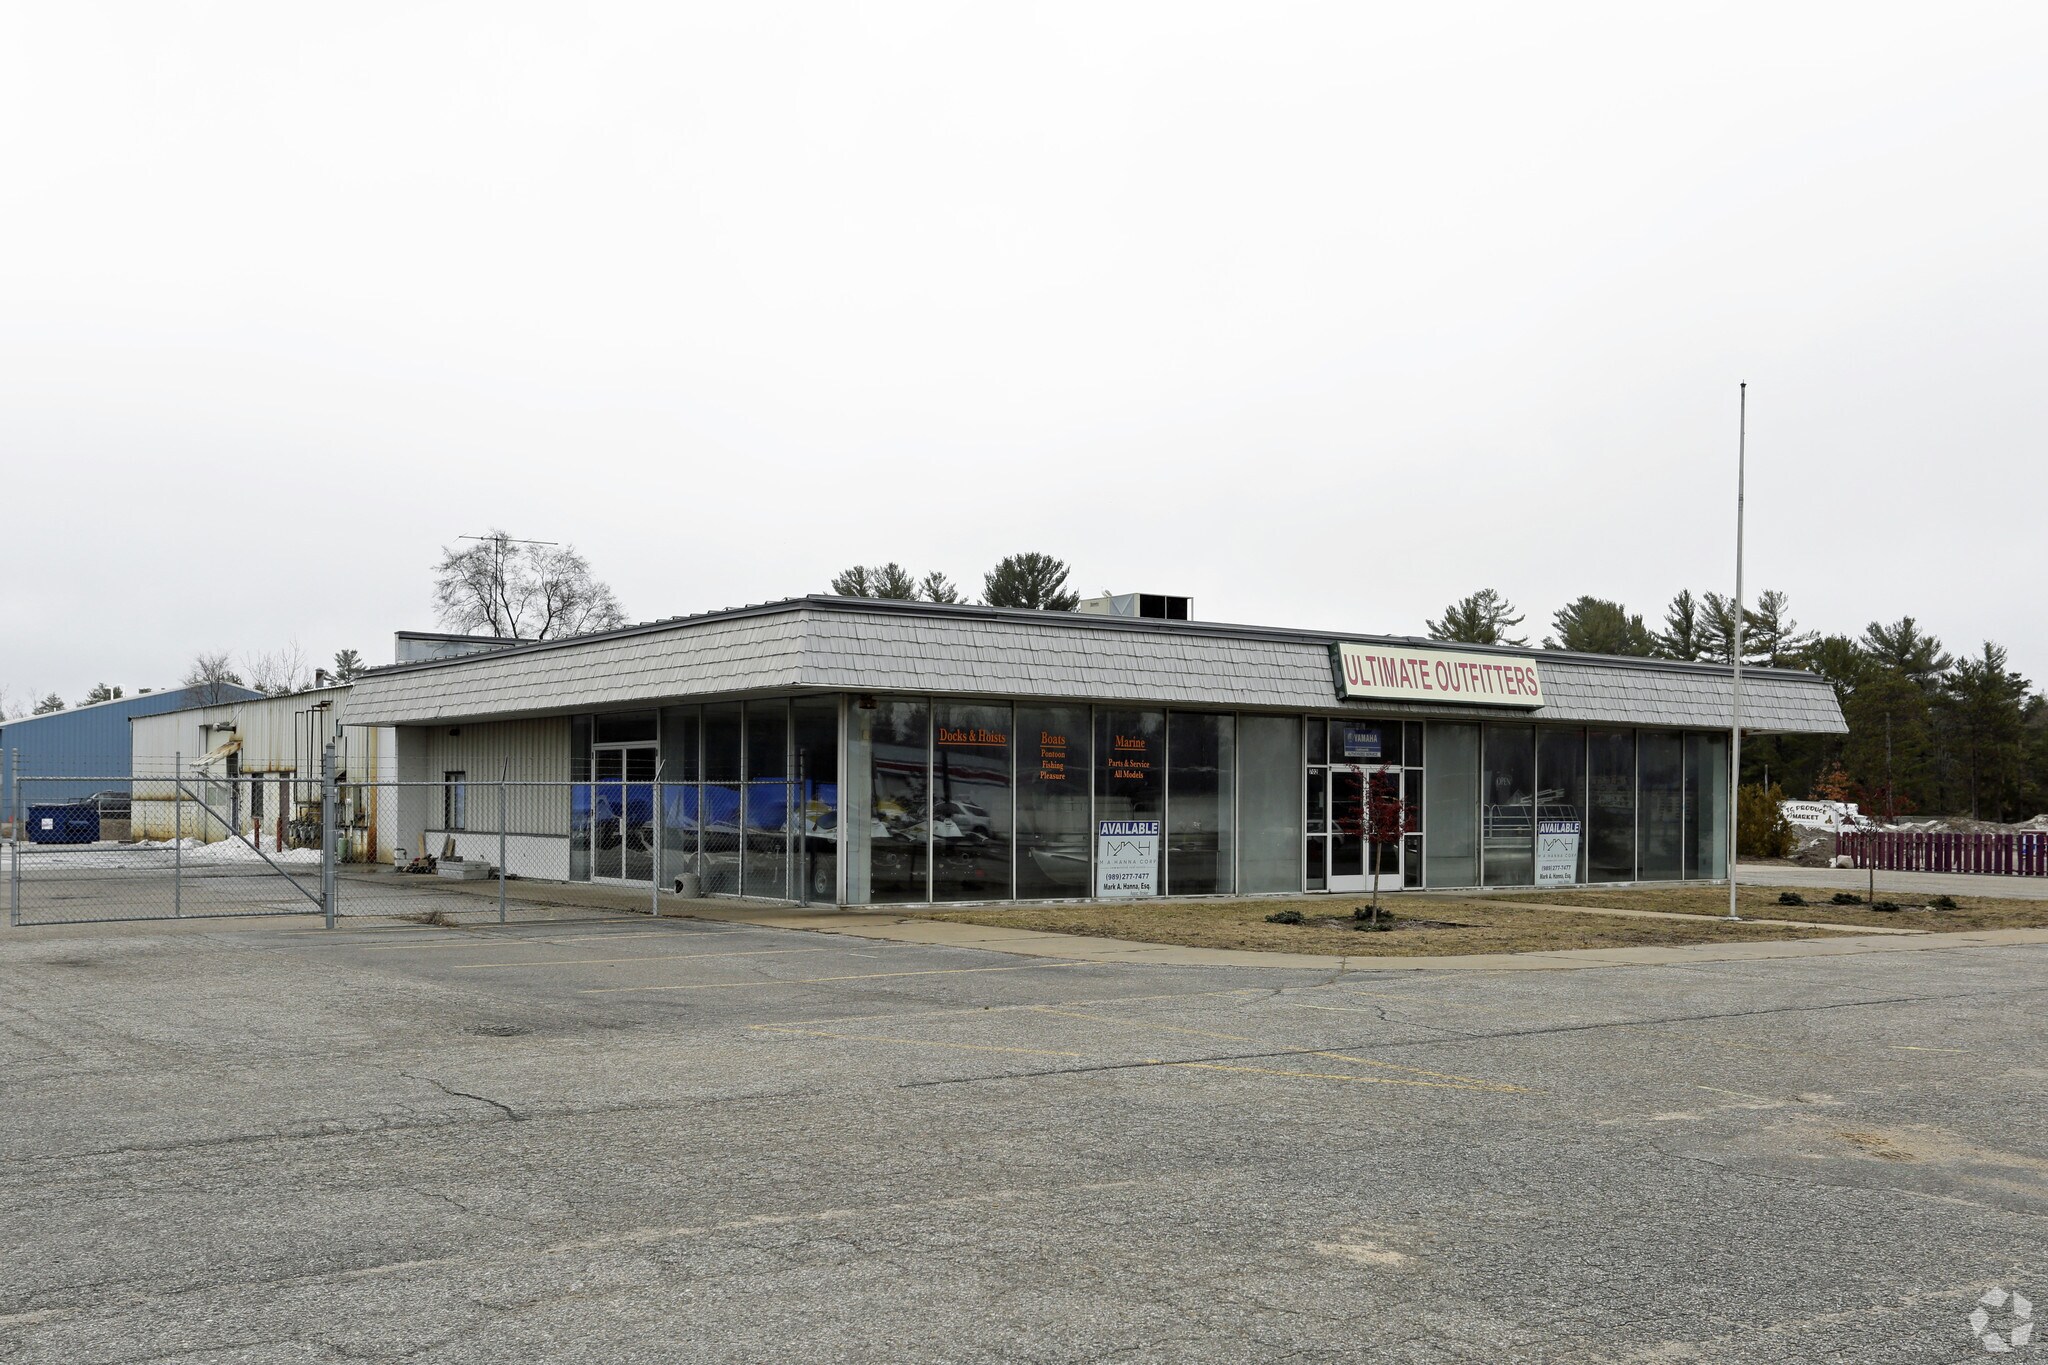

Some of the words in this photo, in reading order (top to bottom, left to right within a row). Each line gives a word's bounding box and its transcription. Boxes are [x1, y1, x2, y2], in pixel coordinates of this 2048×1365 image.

[1343, 653, 1433, 690] ULTIMATE
[1435, 660, 1538, 697] OUTFITTERS
[939, 728, 967, 744] Docks
[969, 730, 976, 743] &
[978, 729, 1006, 744] Hoists
[1041, 732, 1066, 745] Boats
[1354, 733, 1378, 743] YAMAHA
[1115, 735, 1145, 748] Marine
[1041, 749, 1066, 759] Pontoon
[1042, 760, 1064, 772] Fishing
[1108, 758, 1123, 768] Parts
[1124, 759, 1129, 768] &
[1130, 759, 1150, 769] Service
[1040, 770, 1066, 780] Pleasure
[1114, 770, 1122, 779] All
[1123, 770, 1144, 779] Models
[1496, 776, 1511, 786] OPEN
[1796, 805, 1827, 815] PRODUCE
[1101, 822, 1158, 835] AVAILABLE
[1540, 823, 1580, 833] AVAILABLE
[1123, 882, 1140, 890] Hanna,
[1140, 882, 1152, 890] Esq.
